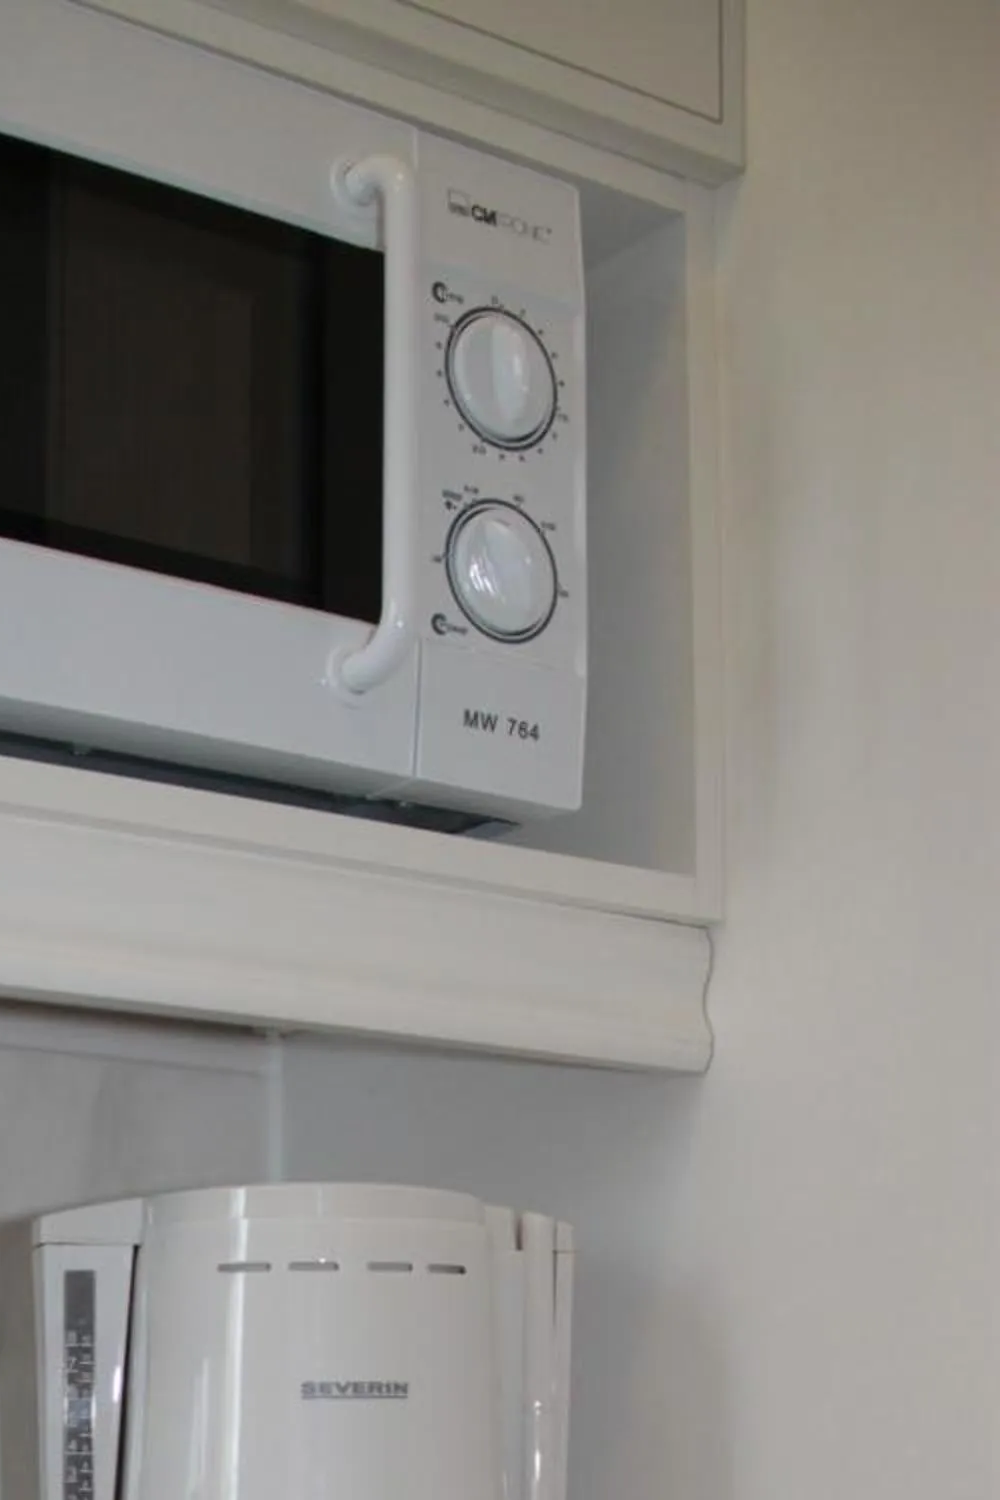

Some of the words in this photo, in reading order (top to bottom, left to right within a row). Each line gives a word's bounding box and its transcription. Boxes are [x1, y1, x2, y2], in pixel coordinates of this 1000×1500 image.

[463, 709, 498, 732] MW
[507, 718, 541, 741] 764
[300, 1380, 408, 1397] SEVERIN
